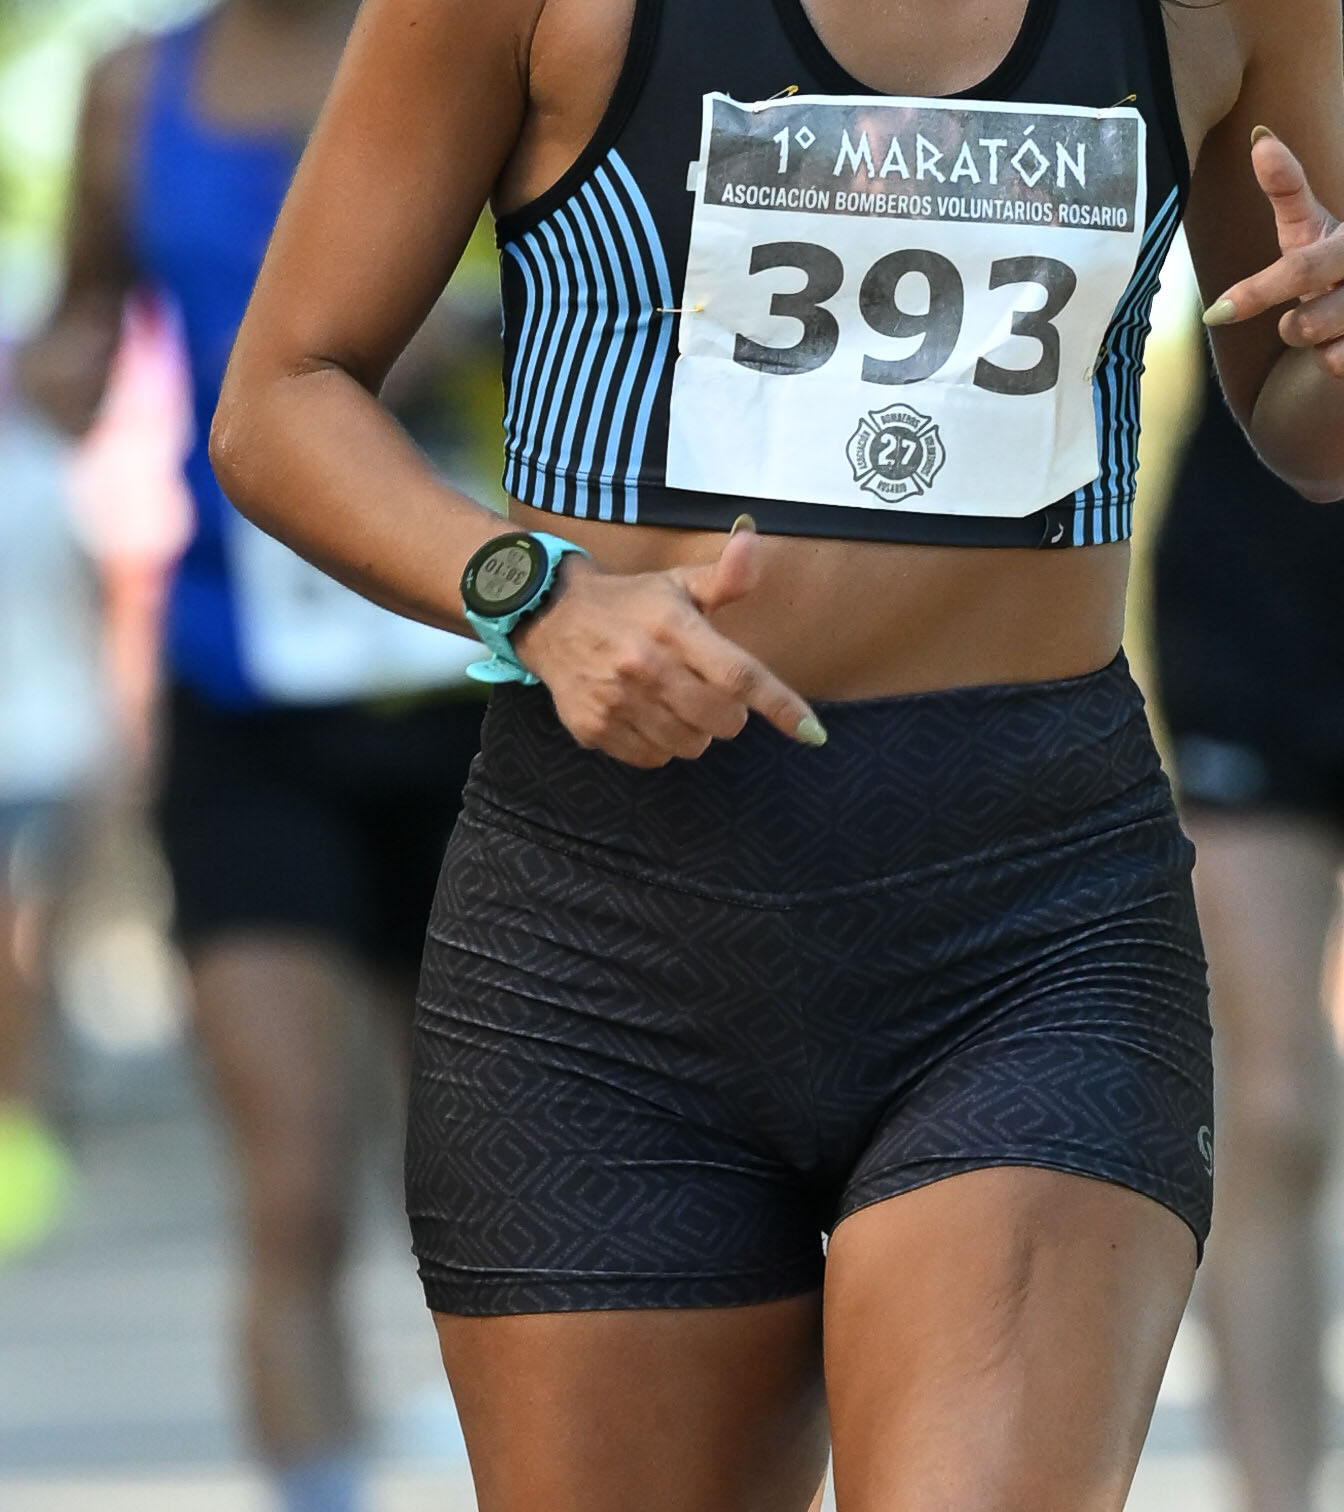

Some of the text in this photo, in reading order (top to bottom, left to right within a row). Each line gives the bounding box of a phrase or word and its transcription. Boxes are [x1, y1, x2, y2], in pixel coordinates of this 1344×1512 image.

[832, 124, 1087, 189] MARATÓN
[721, 182, 1128, 228] ASOCIACIÓN BOMBEROS VOLUNTARIOS ROSARIO
[732, 241, 1077, 395] 393
[877, 433, 917, 466] 27
